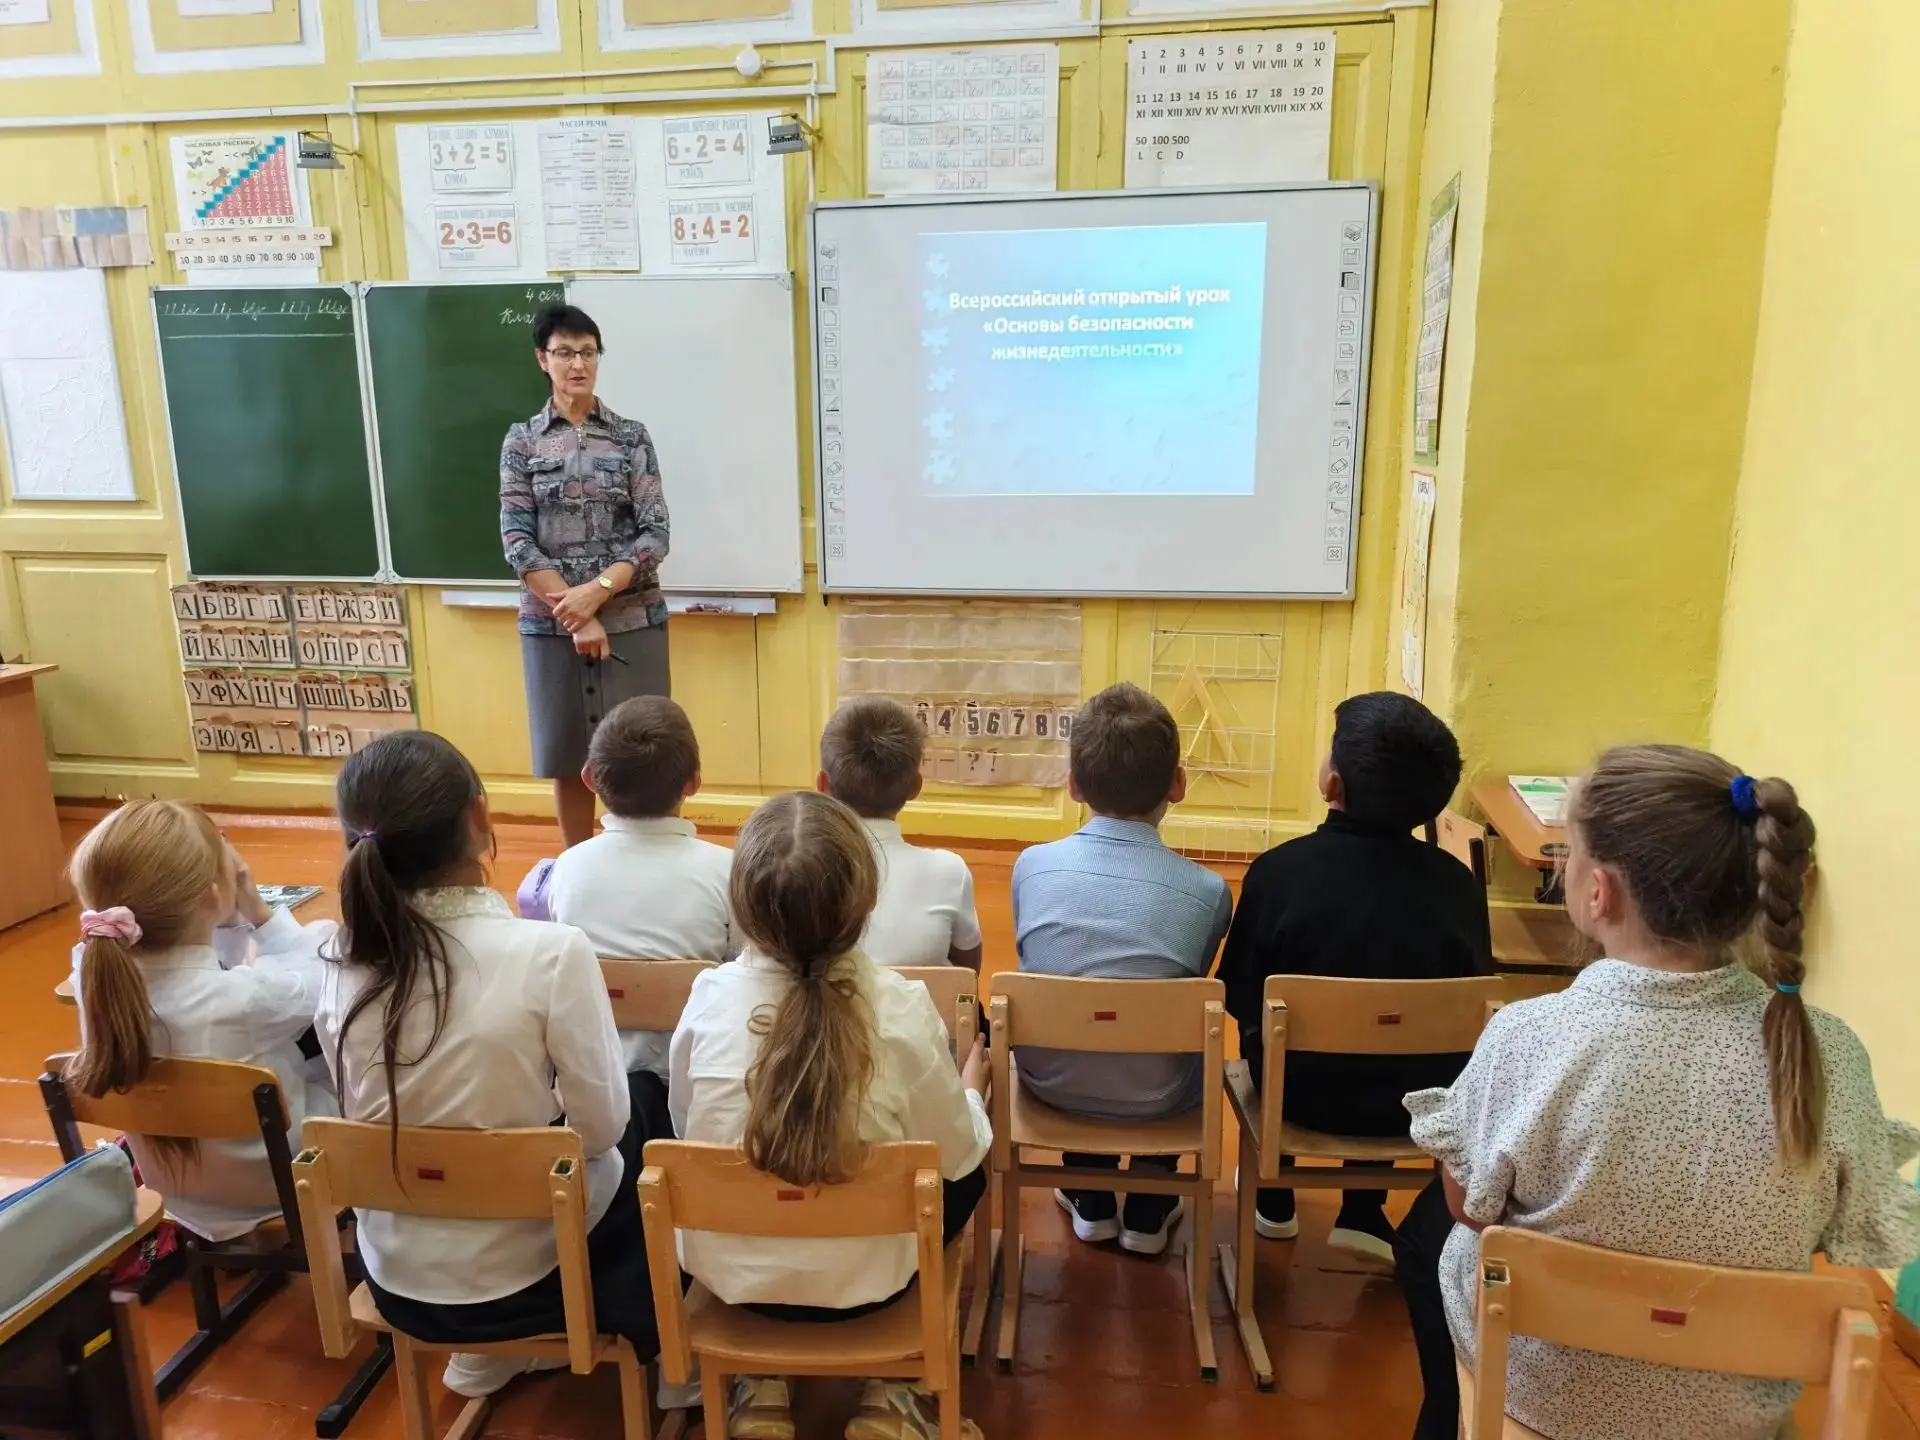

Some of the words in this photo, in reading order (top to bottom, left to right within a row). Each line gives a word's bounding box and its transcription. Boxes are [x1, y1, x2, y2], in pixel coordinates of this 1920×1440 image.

[1142, 51, 1146, 59] 1
[1160, 50, 1165, 58] 2
[1180, 49, 1185, 57] 3
[1199, 48, 1204, 56] 4
[1218, 47, 1223, 55] 5
[1238, 45, 1243, 54] 6
[1257, 45, 1263, 53] 7
[1277, 44, 1282, 52] 8
[1297, 43, 1302, 51] 9
[1313, 42, 1325, 50] 10
[1177, 64, 1186, 72] III
[1196, 64, 1206, 72] IV
[1217, 63, 1223, 71] V
[1235, 61, 1244, 70] VI
[1253, 60, 1265, 69] VII
[1271, 60, 1286, 68] VIII
[1294, 59, 1303, 67] IX
[1315, 58, 1321, 67] X
[1136, 95, 1146, 103] 11
[1152, 94, 1163, 102] 12
[1170, 93, 1181, 101] 13
[1188, 92, 1200, 100] 14
[1207, 91, 1218, 100] 15
[1225, 91, 1237, 99] 16
[1246, 90, 1258, 98] 17
[1271, 89, 1282, 97] 18
[1293, 88, 1305, 96] 19
[1311, 87, 1323, 95] 20
[1136, 110, 1145, 118] XI
[1167, 109, 1182, 117] XIII
[1185, 108, 1201, 116] XIV
[1206, 107, 1218, 115] XV
[1222, 106, 1238, 115] XVI
[1242, 106, 1261, 114] XVII
[1264, 105, 1286, 113] XVIII
[1290, 103, 1306, 112] XIX
[1310, 103, 1323, 111] XX
[1136, 137, 1147, 145] 50
[1152, 136, 1169, 144] 100
[1172, 136, 1189, 144] 500
[1177, 151, 1183, 159] D
[219, 255, 228, 263] 40
[273, 253, 282, 261] 80
[301, 253, 314, 261] 100
[950, 288, 1084, 311] Всероссийский
[1089, 285, 1180, 308] открытый
[1187, 287, 1230, 307] урок
[984, 318, 1063, 333] «Основы
[1068, 314, 1194, 332] безопасности
[938, 710, 951, 733] 4
[967, 710, 979, 728] 5
[987, 712, 1000, 734] 6
[1014, 714, 1025, 734] 7
[1036, 715, 1047, 736] 8
[1059, 716, 1070, 737] 9
